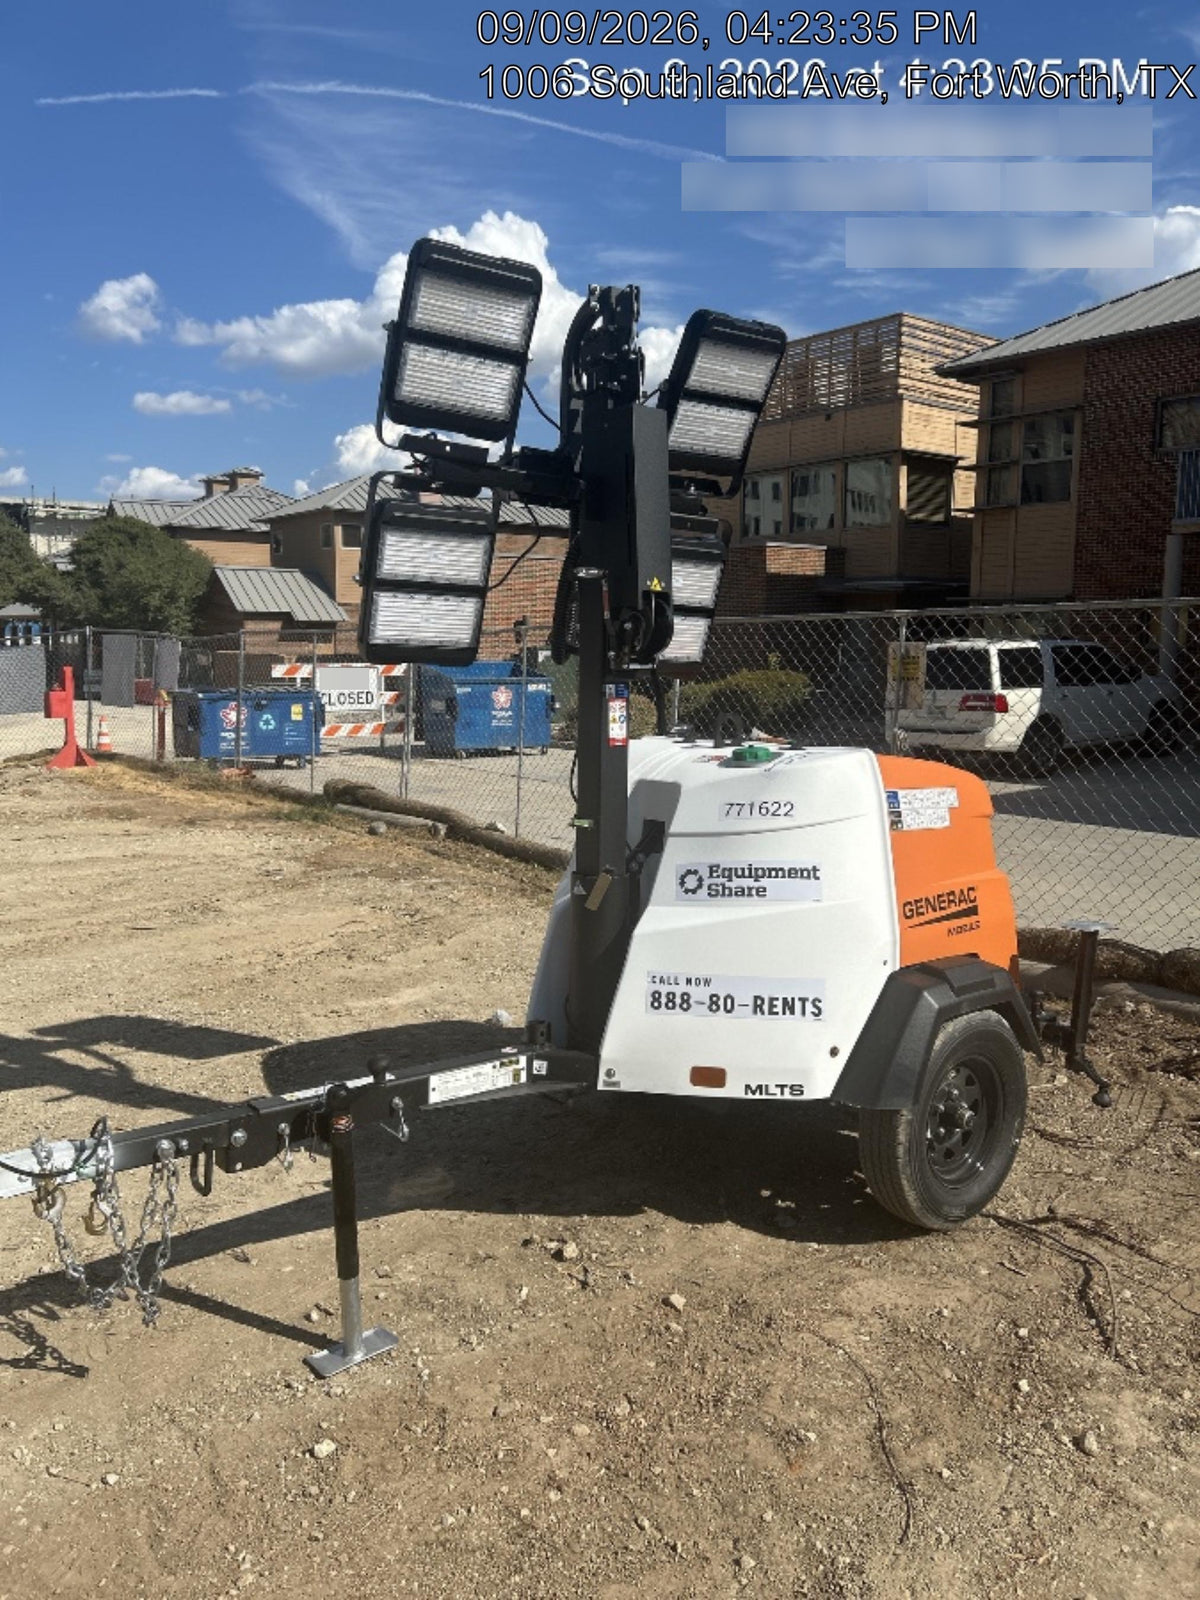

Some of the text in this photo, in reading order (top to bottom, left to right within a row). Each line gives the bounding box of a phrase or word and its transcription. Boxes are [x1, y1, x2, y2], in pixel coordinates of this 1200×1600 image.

[724, 801, 794, 817] 771622
[707, 863, 820, 882] Equipment
[707, 883, 767, 898] Share
[902, 886, 978, 920] GENERAC
[650, 975, 712, 988] CALL NOW
[650, 989, 823, 1018] 888-80-RENTS
[744, 1084, 804, 1097] MLTS
